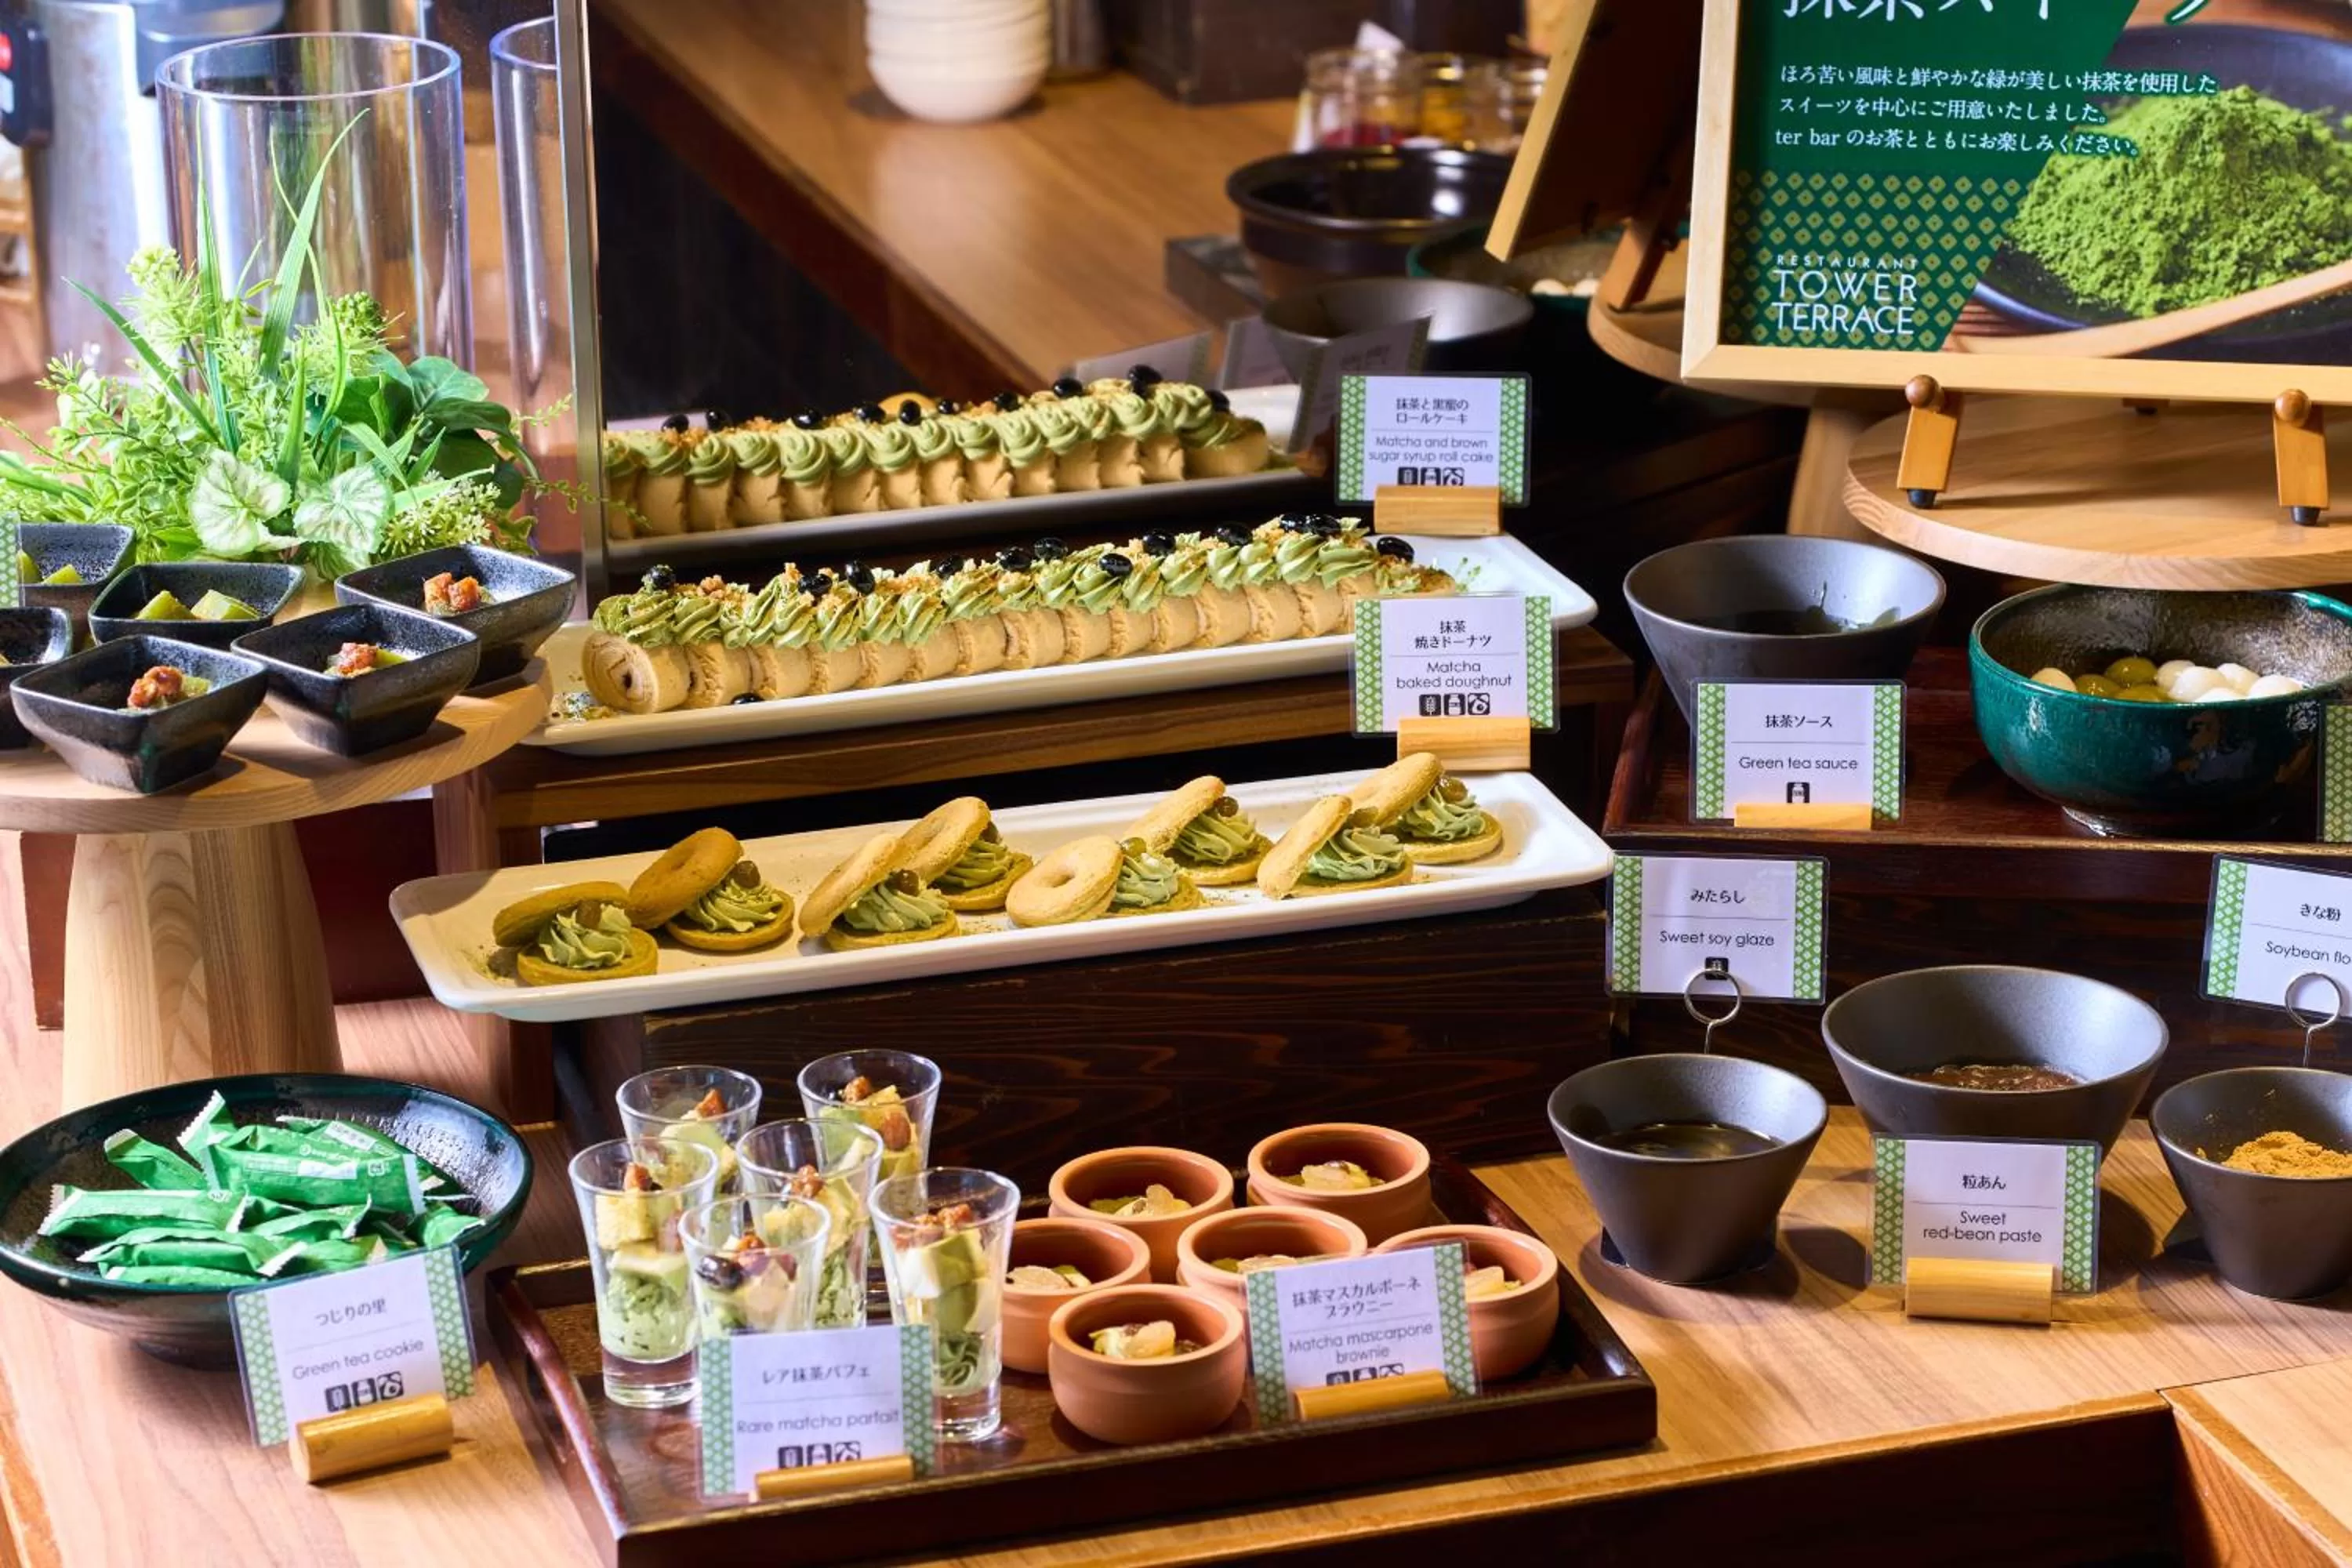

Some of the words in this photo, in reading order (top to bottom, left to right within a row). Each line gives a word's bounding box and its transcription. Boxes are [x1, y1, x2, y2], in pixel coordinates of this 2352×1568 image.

[1780, 65, 2217, 94] ほろ苦い風味と鮮やかな緑が美しい抹茶を使用した
[1780, 96, 2106, 123] スイーツを中心にご用意いたしました。
[1775, 129, 1802, 145] ter
[1809, 128, 1840, 146] bar
[1846, 128, 2139, 155] のお茶とともにお楽しみください。
[1776, 254, 1918, 270] RESTAURANT
[1773, 269, 1918, 303] TOWER
[1771, 301, 1915, 335] TERRACE
[1396, 412, 1468, 425] ロールケーキ
[1376, 436, 1421, 448] Matcha
[1425, 436, 1448, 448] and
[1451, 436, 1488, 448] brown
[1369, 452, 1400, 463] sugar
[1403, 452, 1437, 463] syrup
[1439, 450, 1458, 462] roll
[1461, 452, 1494, 463] cake
[1439, 620, 1467, 634] 抹茶
[1414, 634, 1492, 650] 焼きドーナツ
[1426, 661, 1482, 673] Matcha
[1396, 677, 1442, 689] baked
[1445, 676, 1512, 691] doughnut
[1765, 714, 1834, 728] 抹茶ソース
[1738, 757, 1784, 770] Green
[1788, 757, 1812, 769] tea
[1815, 757, 1859, 770] sauce
[1690, 889, 1747, 904] みたらし
[2299, 903, 2341, 922] きな粉
[1659, 931, 1704, 944] Sweet
[1708, 935, 1733, 947] soy
[1735, 934, 1775, 948] glaze
[2265, 940, 2330, 963] Soybean
[1961, 1174, 2006, 1190] 粒あん
[1960, 1210, 2006, 1225] Sweet
[1922, 1226, 1995, 1241] red-bean
[1999, 1229, 2042, 1243] paste
[315, 1298, 387, 1326] つじりの里
[1288, 1334, 1343, 1354] Matcha
[1346, 1322, 1433, 1348] mascarpone
[292, 1361, 341, 1380] Green
[343, 1352, 370, 1367] tea
[372, 1338, 424, 1361] cookie
[1335, 1344, 1390, 1365] brownie
[737, 1421, 774, 1434] Rare
[778, 1414, 844, 1431] matcha
[847, 1410, 900, 1428] parfait
